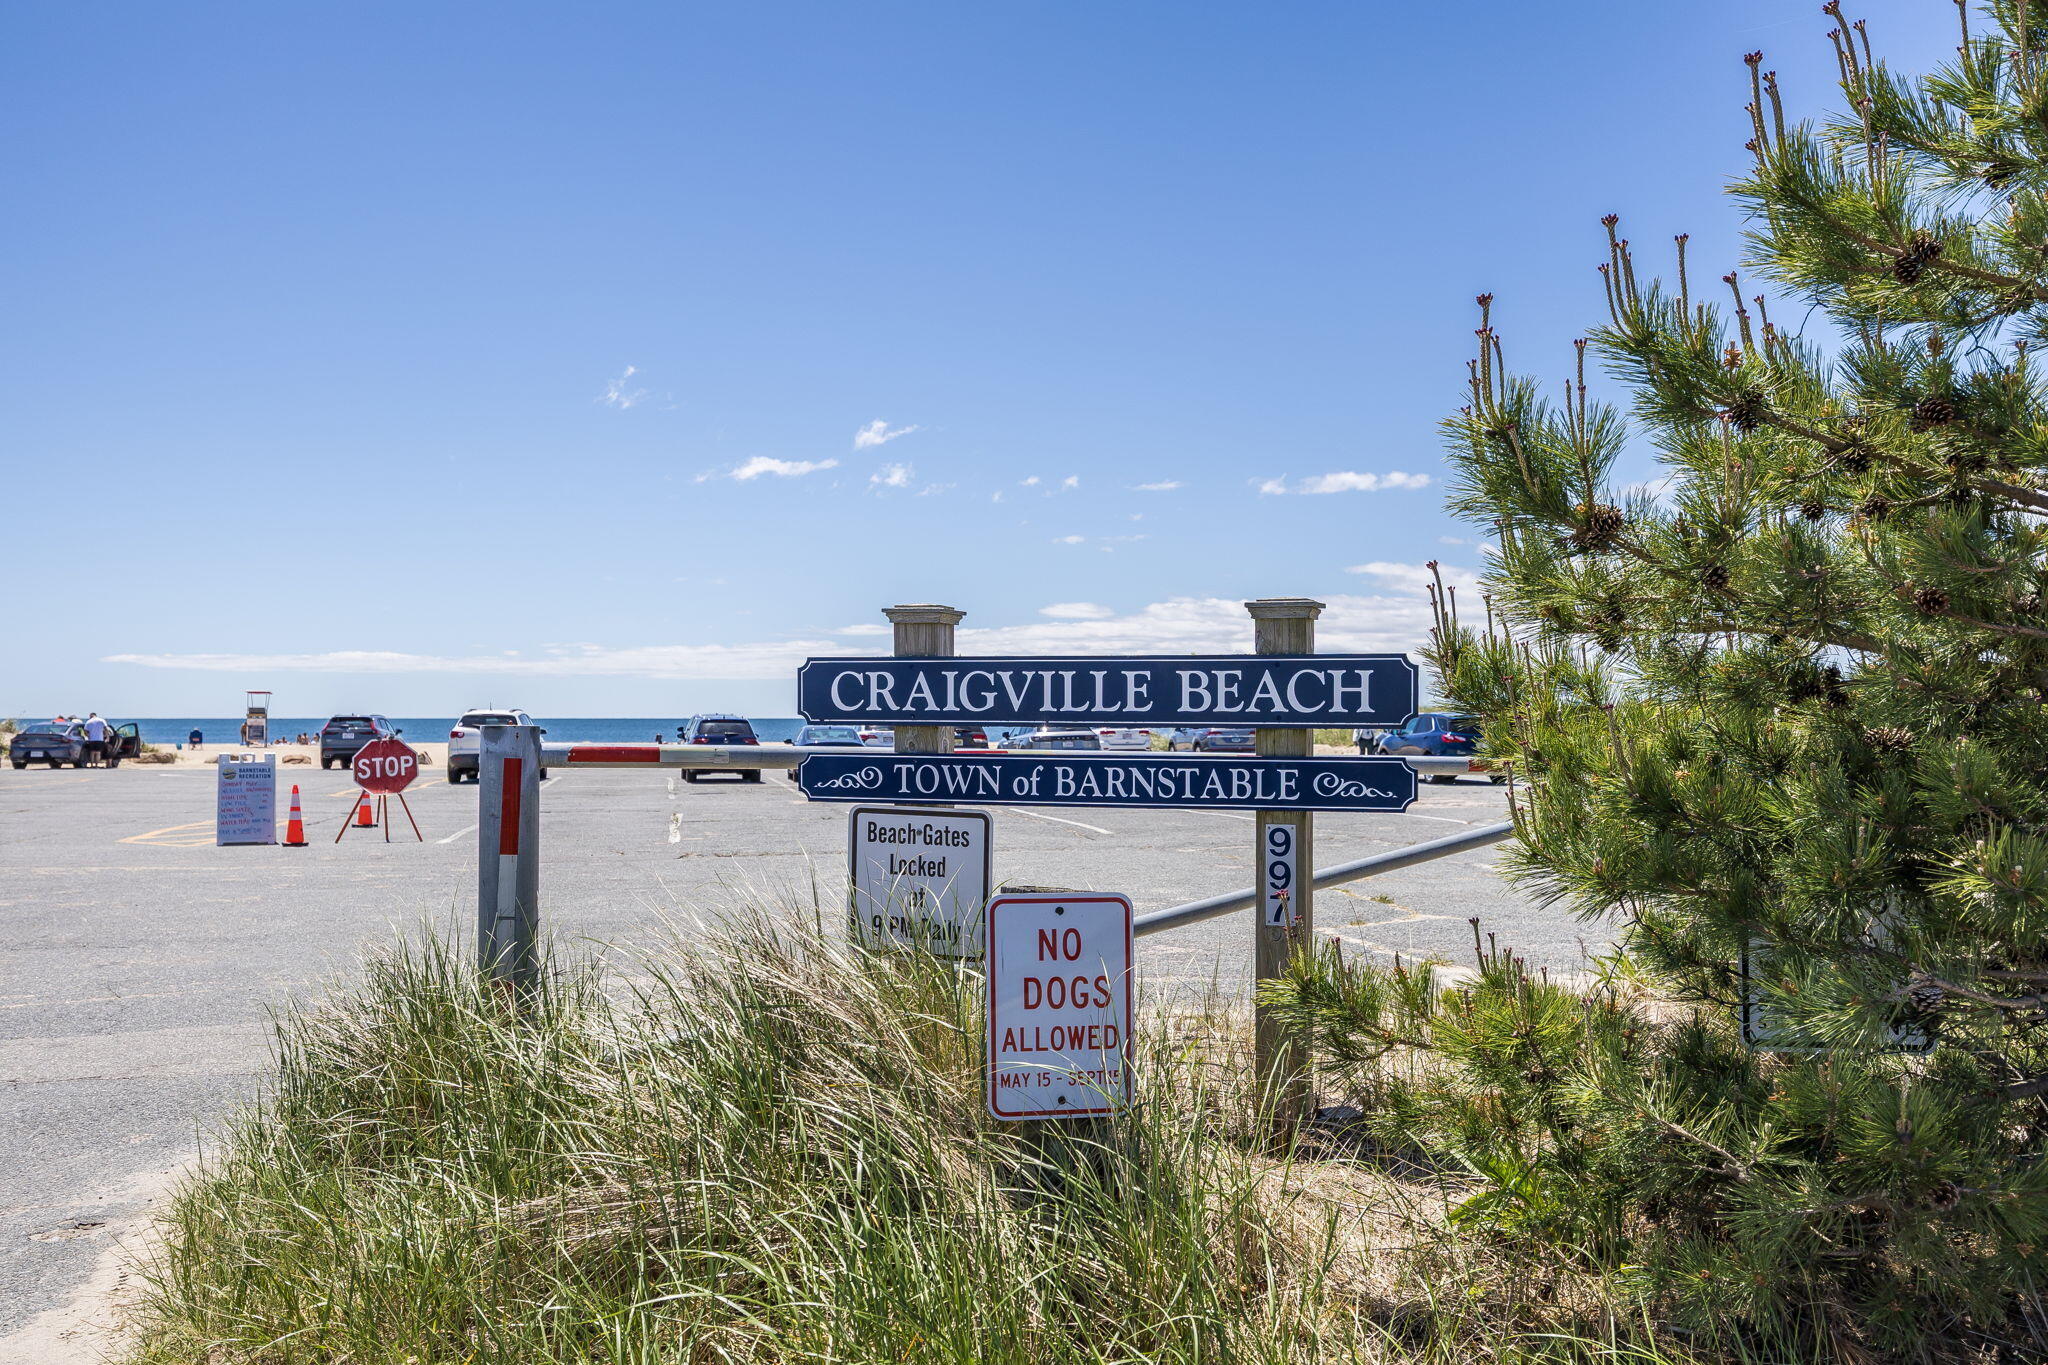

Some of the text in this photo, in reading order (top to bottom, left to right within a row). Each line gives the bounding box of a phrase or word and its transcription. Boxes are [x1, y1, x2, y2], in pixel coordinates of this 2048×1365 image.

[831, 669, 1375, 713] CRAIGVILLE BEACH
[357, 755, 413, 779] STOP
[893, 764, 1300, 800] TOWN of BARNSTABLE
[867, 821, 970, 848] Beach Gates
[889, 853, 946, 878] Locked
[1268, 827, 1292, 923] 997
[1038, 928, 1082, 961] NO
[1023, 975, 1111, 1010] DOGS
[1001, 1024, 1119, 1053] ALLOWED
[1000, 1072, 1031, 1088] MAY
[1037, 1072, 1051, 1087] 15
